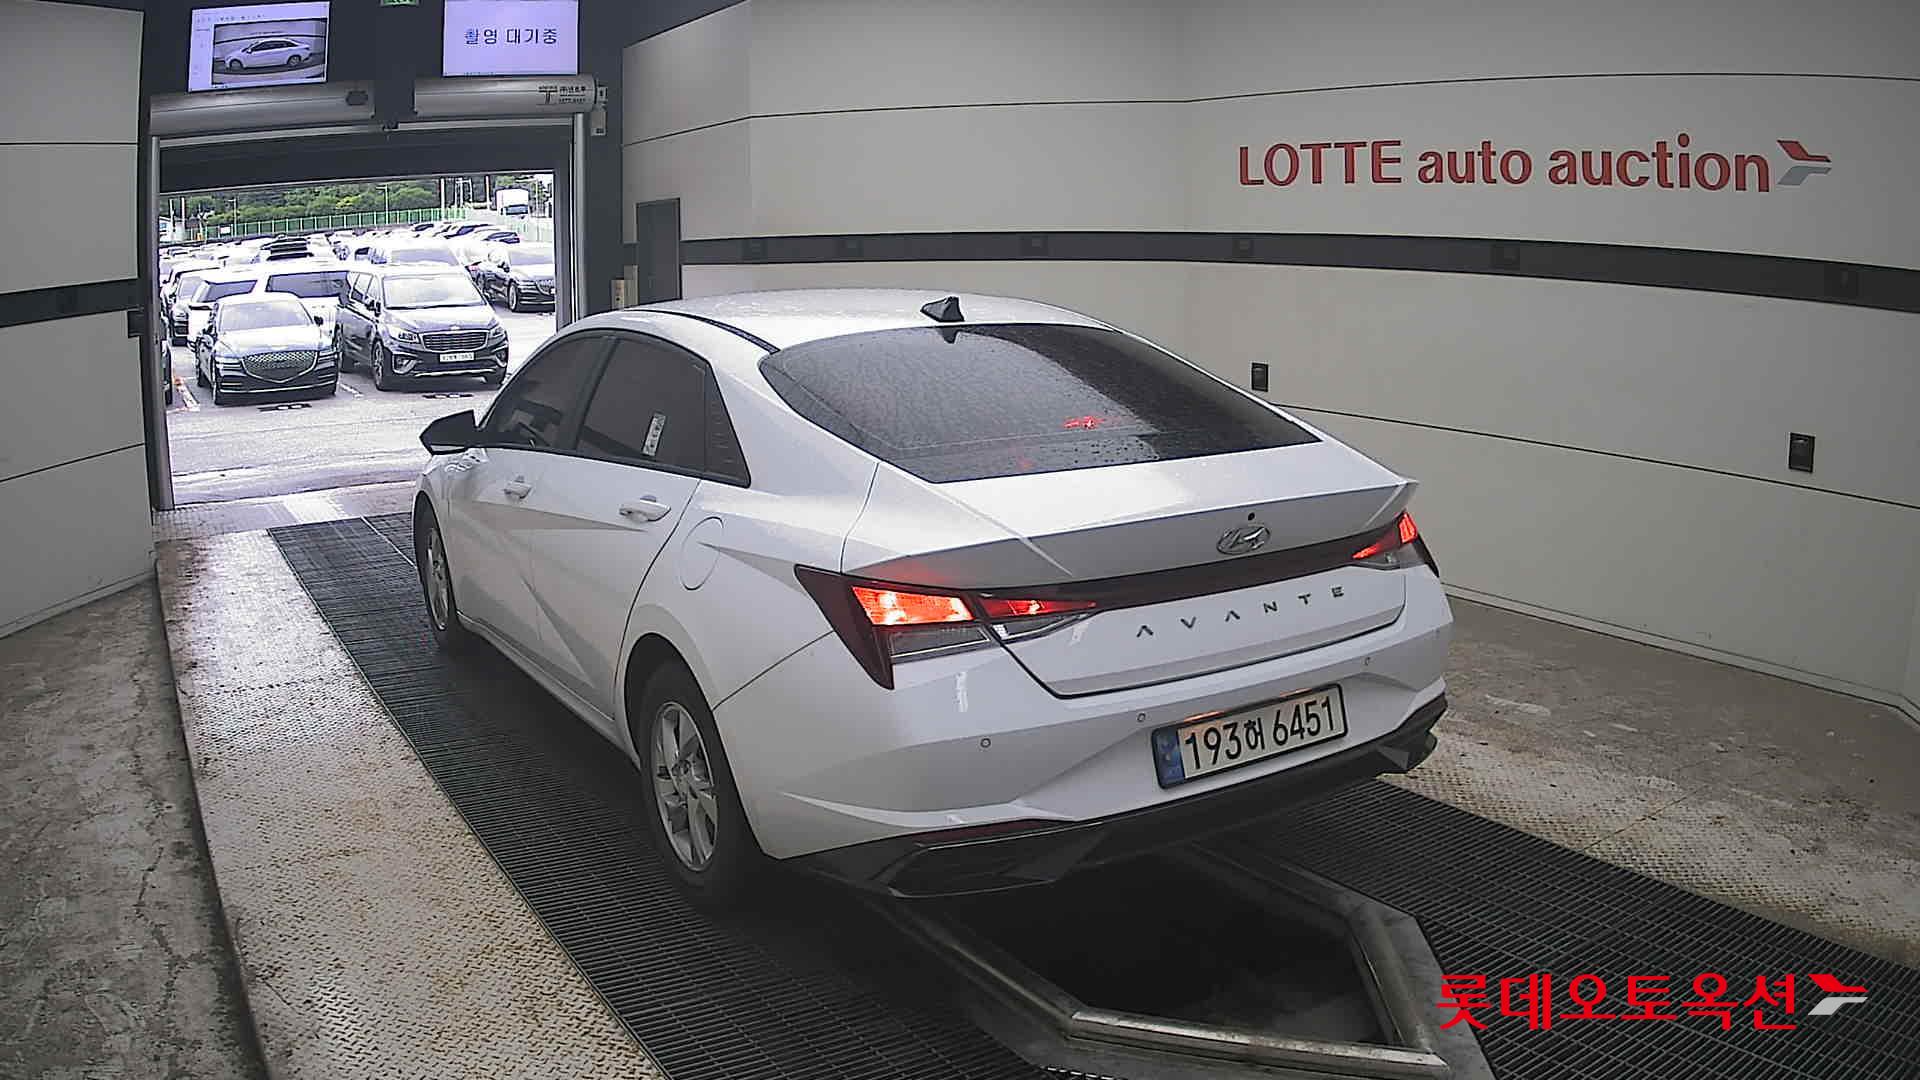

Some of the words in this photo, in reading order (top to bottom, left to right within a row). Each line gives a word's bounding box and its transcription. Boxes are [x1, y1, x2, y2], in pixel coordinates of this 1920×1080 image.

[506, 28, 557, 45] 대기중
[1238, 139, 1402, 187] LOTTE
[1417, 140, 1533, 185] auto
[1547, 132, 1771, 193] auction
[1136, 585, 1344, 639] AVANTE
[1184, 718, 1266, 771] 193허
[1272, 695, 1335, 747] 6451
